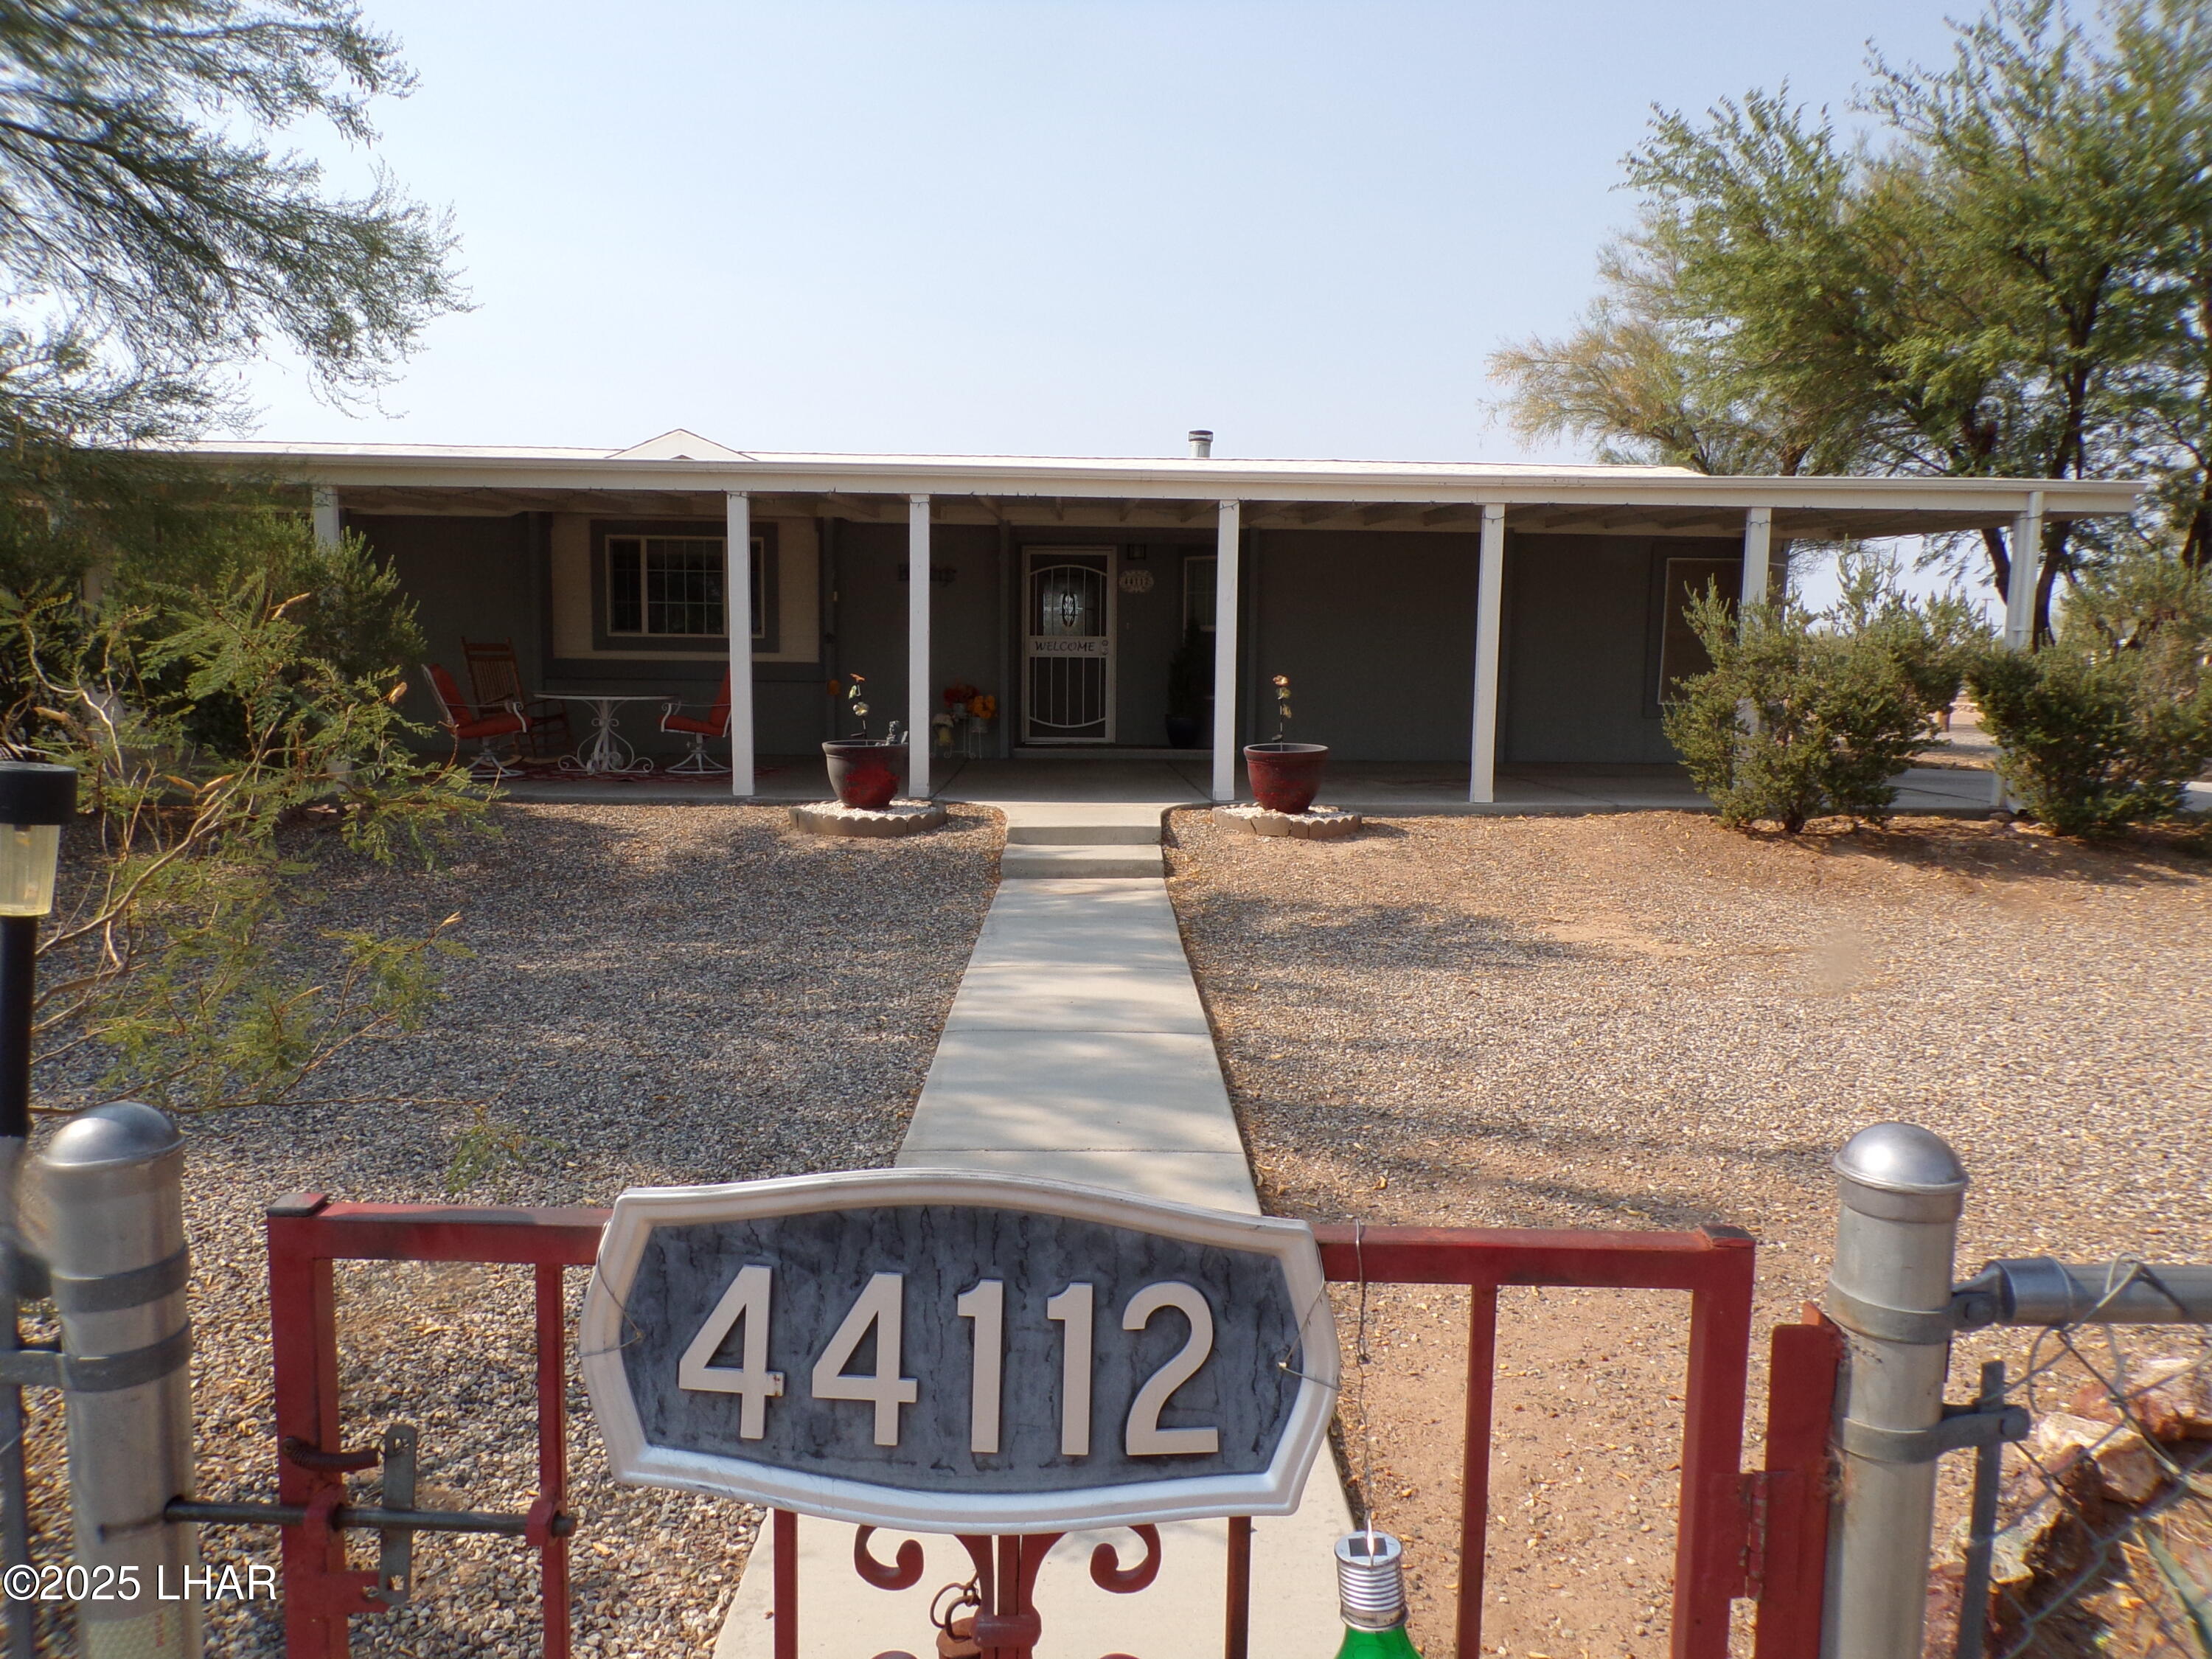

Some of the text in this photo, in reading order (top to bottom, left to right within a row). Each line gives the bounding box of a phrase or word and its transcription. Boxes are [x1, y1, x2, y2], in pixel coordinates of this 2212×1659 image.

[1124, 577, 1149, 585] 44112
[1034, 640, 1096, 653] WELCOME
[678, 1264, 1219, 1456] 44112
